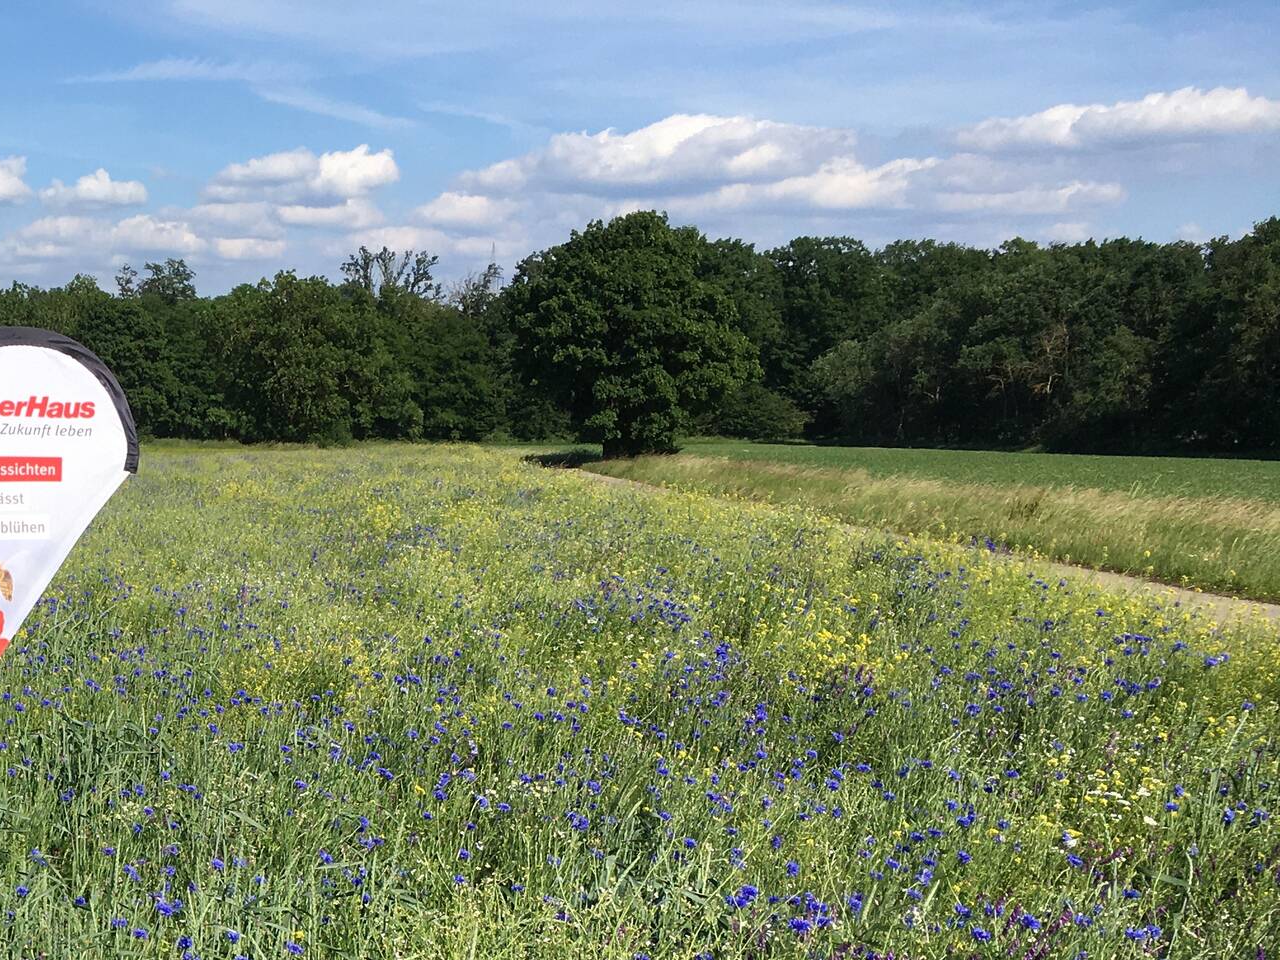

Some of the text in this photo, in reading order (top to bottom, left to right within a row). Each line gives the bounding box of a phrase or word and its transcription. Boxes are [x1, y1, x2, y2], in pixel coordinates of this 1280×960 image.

[0, 422, 52, 439] Zukunft
[55, 425, 92, 437] leben
[0, 521, 45, 534] blühen
